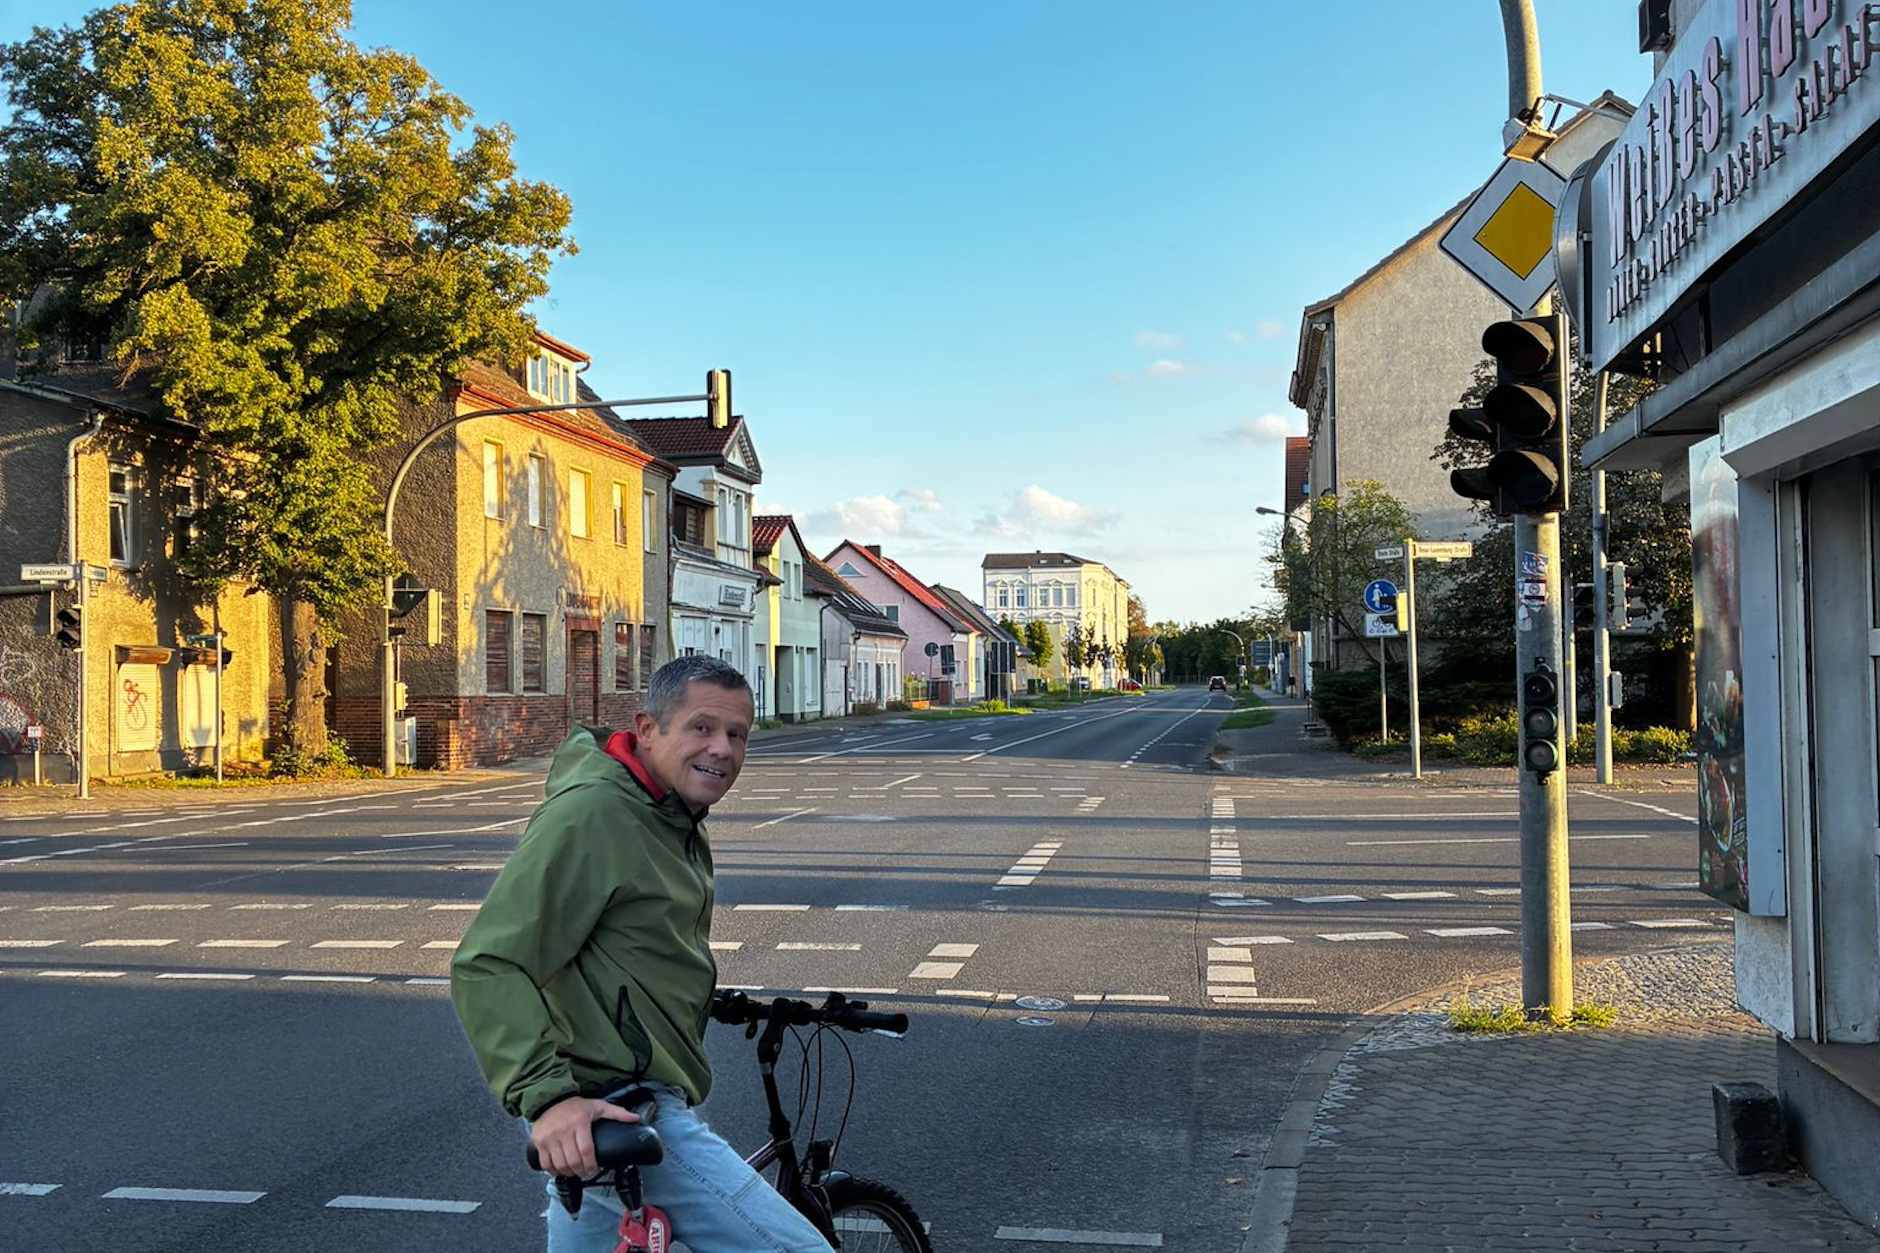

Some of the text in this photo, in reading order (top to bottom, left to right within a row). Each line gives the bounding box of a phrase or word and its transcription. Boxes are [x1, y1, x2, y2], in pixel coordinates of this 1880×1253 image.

[1606, 0, 1833, 269] Weißes Ha
[1649, 192, 1696, 282] BURGER
[1711, 114, 1774, 215] PASTA
[1794, 4, 1872, 134] SALAT
[29, 568, 67, 576] Lindenstraße
